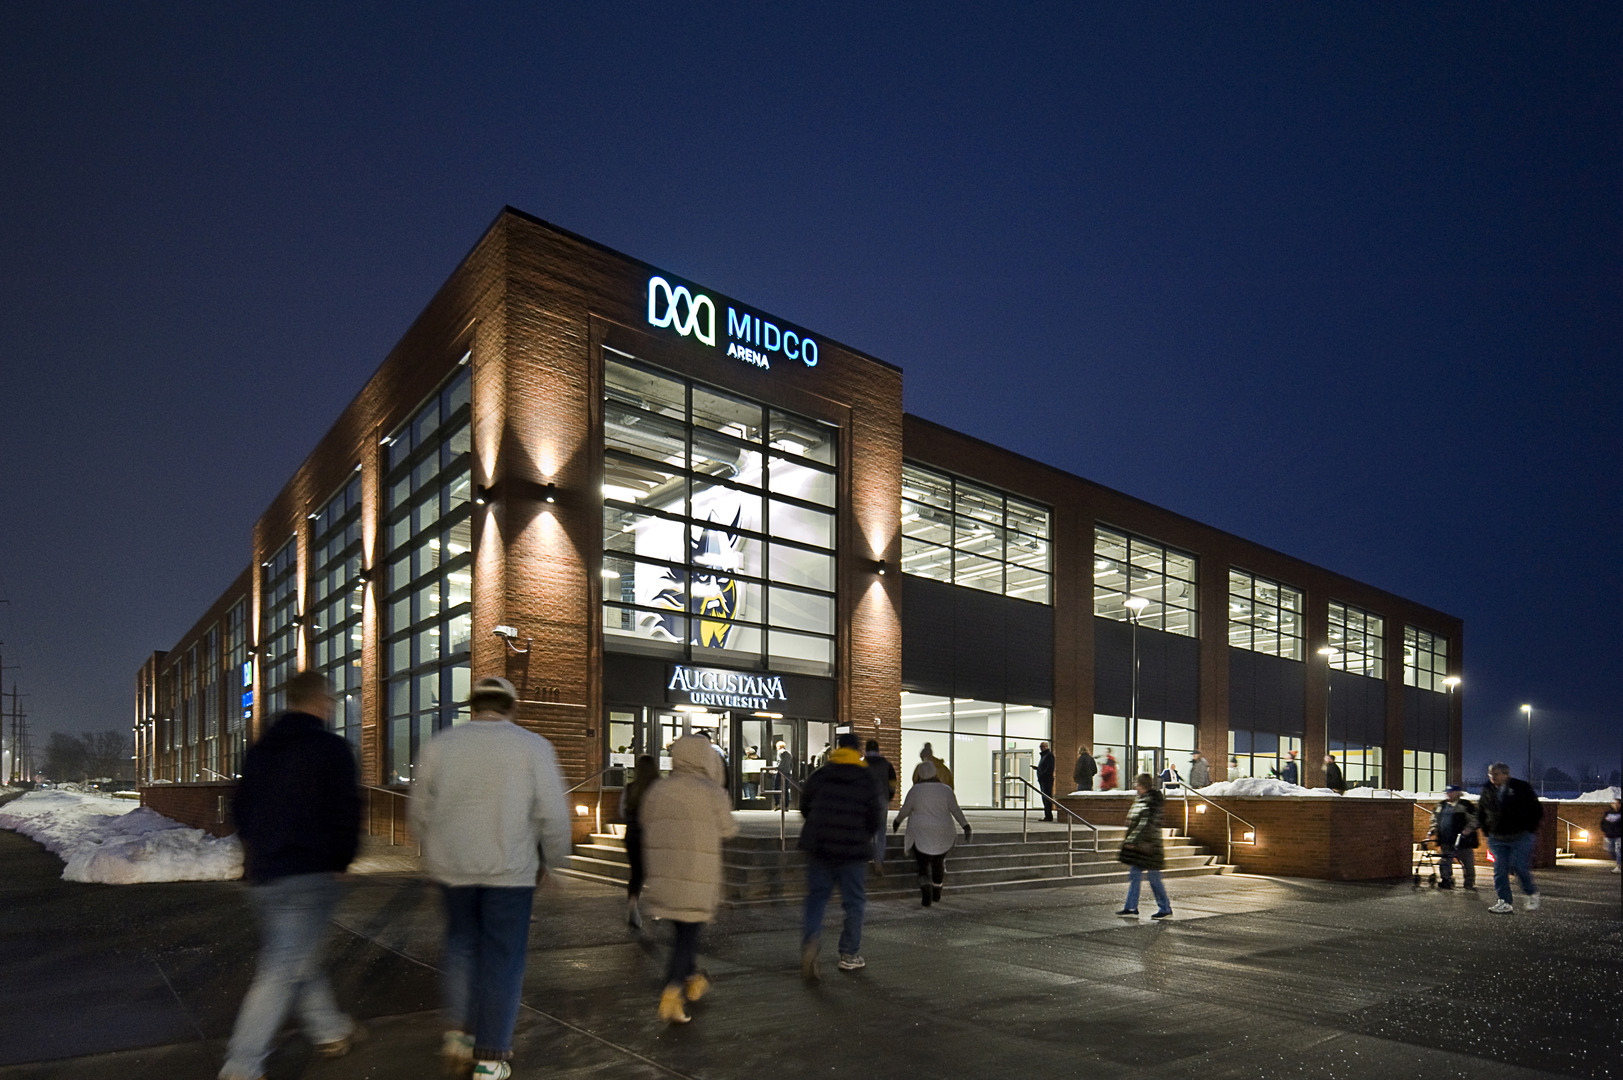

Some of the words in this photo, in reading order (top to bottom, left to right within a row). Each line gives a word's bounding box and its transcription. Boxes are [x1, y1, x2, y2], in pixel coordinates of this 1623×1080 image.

[728, 306, 818, 367] MIDCO
[727, 342, 770, 369] ARENA
[668, 665, 787, 700] AUGUSTANA
[690, 692, 769, 710] UNIVERSITY
